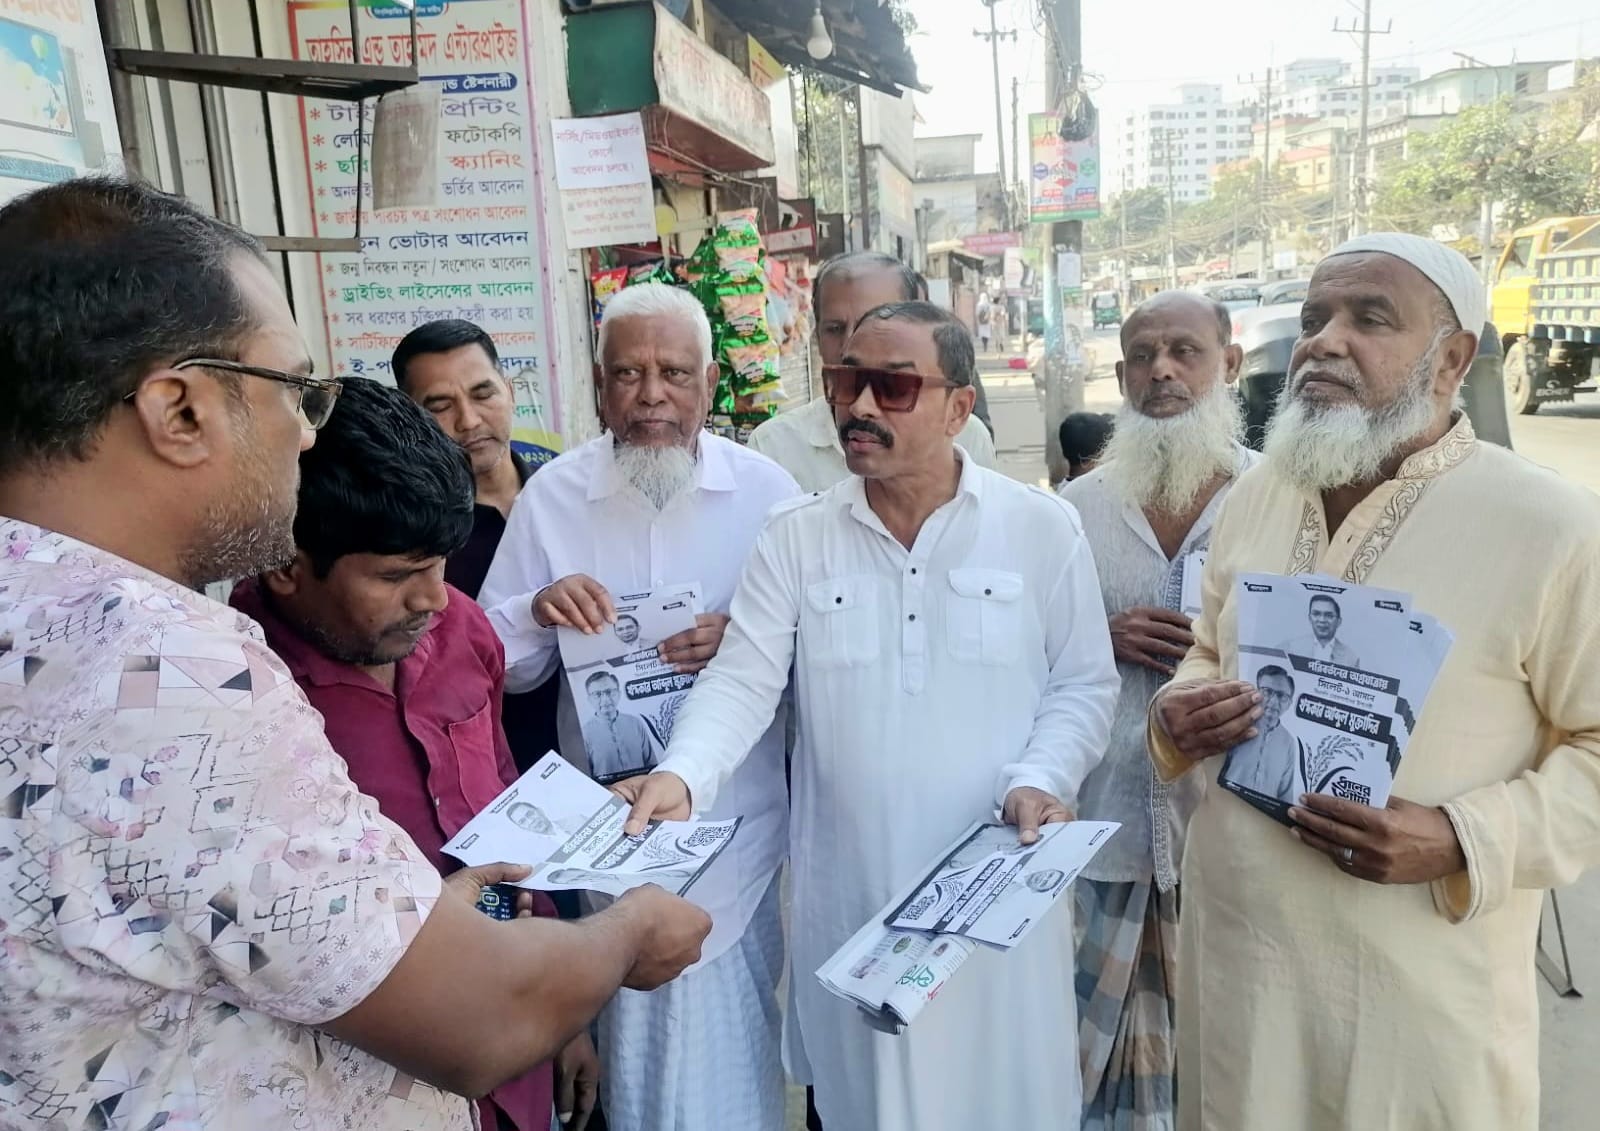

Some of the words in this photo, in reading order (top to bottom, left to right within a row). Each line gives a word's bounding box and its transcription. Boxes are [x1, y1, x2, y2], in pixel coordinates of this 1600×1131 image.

[305, 24, 354, 65] তাহসিন
[362, 35, 384, 66] এন্ড
[443, 18, 518, 66] এন্টারপ্রাইজ
[440, 97, 521, 118] প্রিন্টিং
[333, 127, 375, 149] লেমি
[443, 121, 522, 143] ফটোকপি
[445, 148, 526, 169] স্ক্যানিং
[441, 176, 474, 196] ভর্তির
[479, 179, 525, 196] আবেদন
[434, 206, 480, 223] সংশোধন
[484, 204, 527, 221] আবেদন
[388, 229, 448, 250] ভোটার
[456, 231, 528, 248] আবেদন
[363, 257, 399, 276] নিবন্ধন
[402, 260, 429, 276] নতুন
[440, 258, 484, 275] সংশোধন
[490, 256, 531, 274] আবেদন
[341, 281, 393, 303] ড্রাইভিং
[399, 281, 472, 301] লাইসেন্সের
[477, 280, 534, 299] আবেদন
[345, 311, 363, 325] সব
[489, 306, 512, 321] করা
[517, 306, 534, 321] হয়
[1307, 660, 1349, 680] পরিবর্তনের
[626, 679, 652, 697] খন্দকার
[650, 675, 674, 693] আব্দুল
[1318, 677, 1350, 696] সিলেট-১
[1352, 688, 1376, 703] আসনে
[1299, 696, 1325, 719] খন্দকার
[1323, 705, 1351, 728] আব্দুল
[1348, 711, 1381, 736] মুক্তাদির
